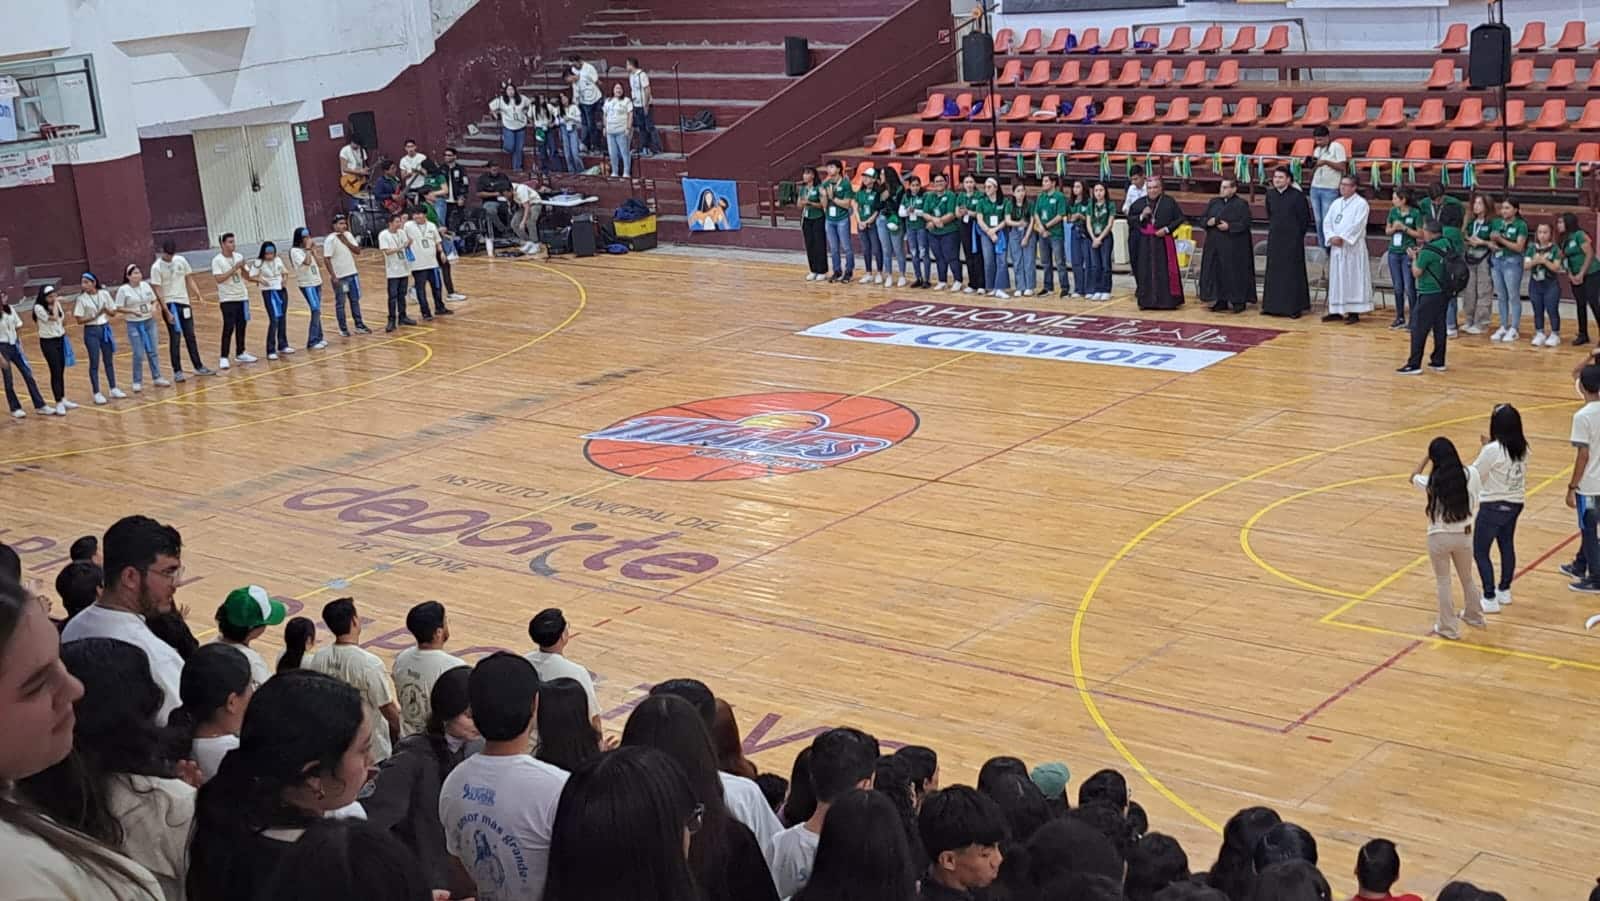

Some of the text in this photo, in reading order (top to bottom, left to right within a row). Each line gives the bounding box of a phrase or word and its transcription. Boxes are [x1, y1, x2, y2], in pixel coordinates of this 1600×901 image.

[893, 303, 1098, 330] AHOME
[914, 331, 1177, 366] Chevron
[436, 473, 550, 499] INSTITUTO
[674, 516, 722, 533] DEL
[283, 484, 720, 580] deporte
